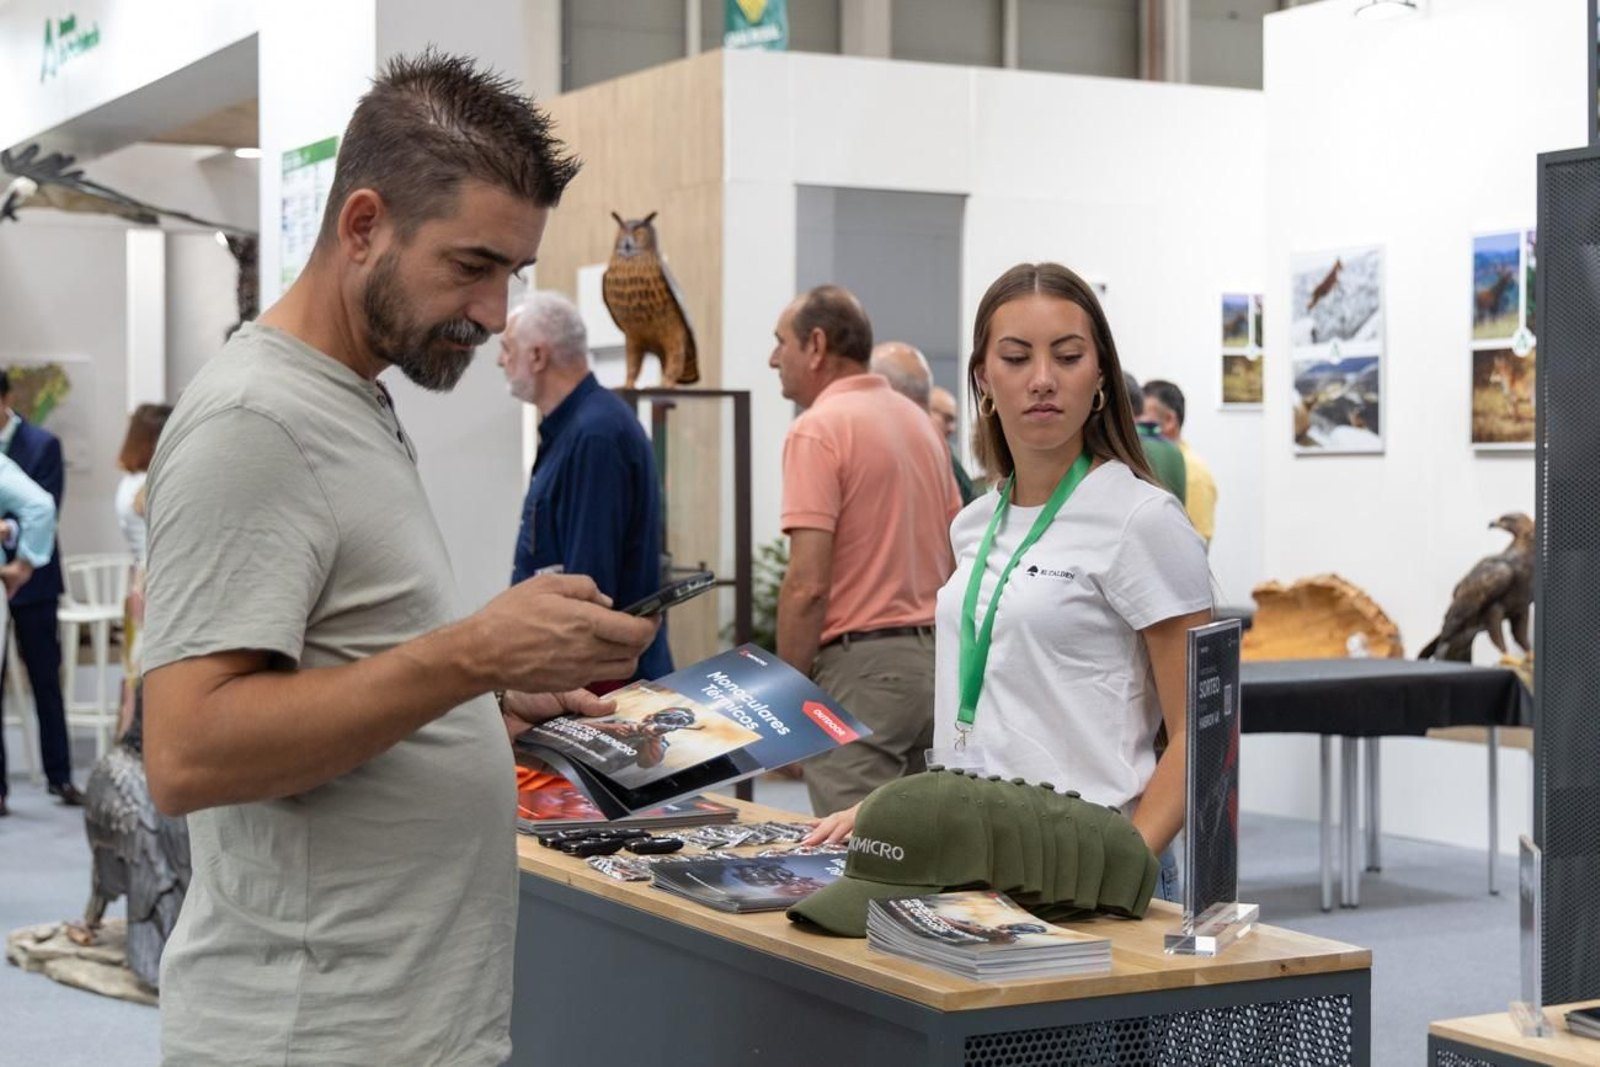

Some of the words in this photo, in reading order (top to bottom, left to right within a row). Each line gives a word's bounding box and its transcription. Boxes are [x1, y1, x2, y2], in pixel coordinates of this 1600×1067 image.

[701, 684, 759, 731] Térmicos
[706, 671, 791, 736] Monoculares
[813, 708, 847, 737] OUTDOOR
